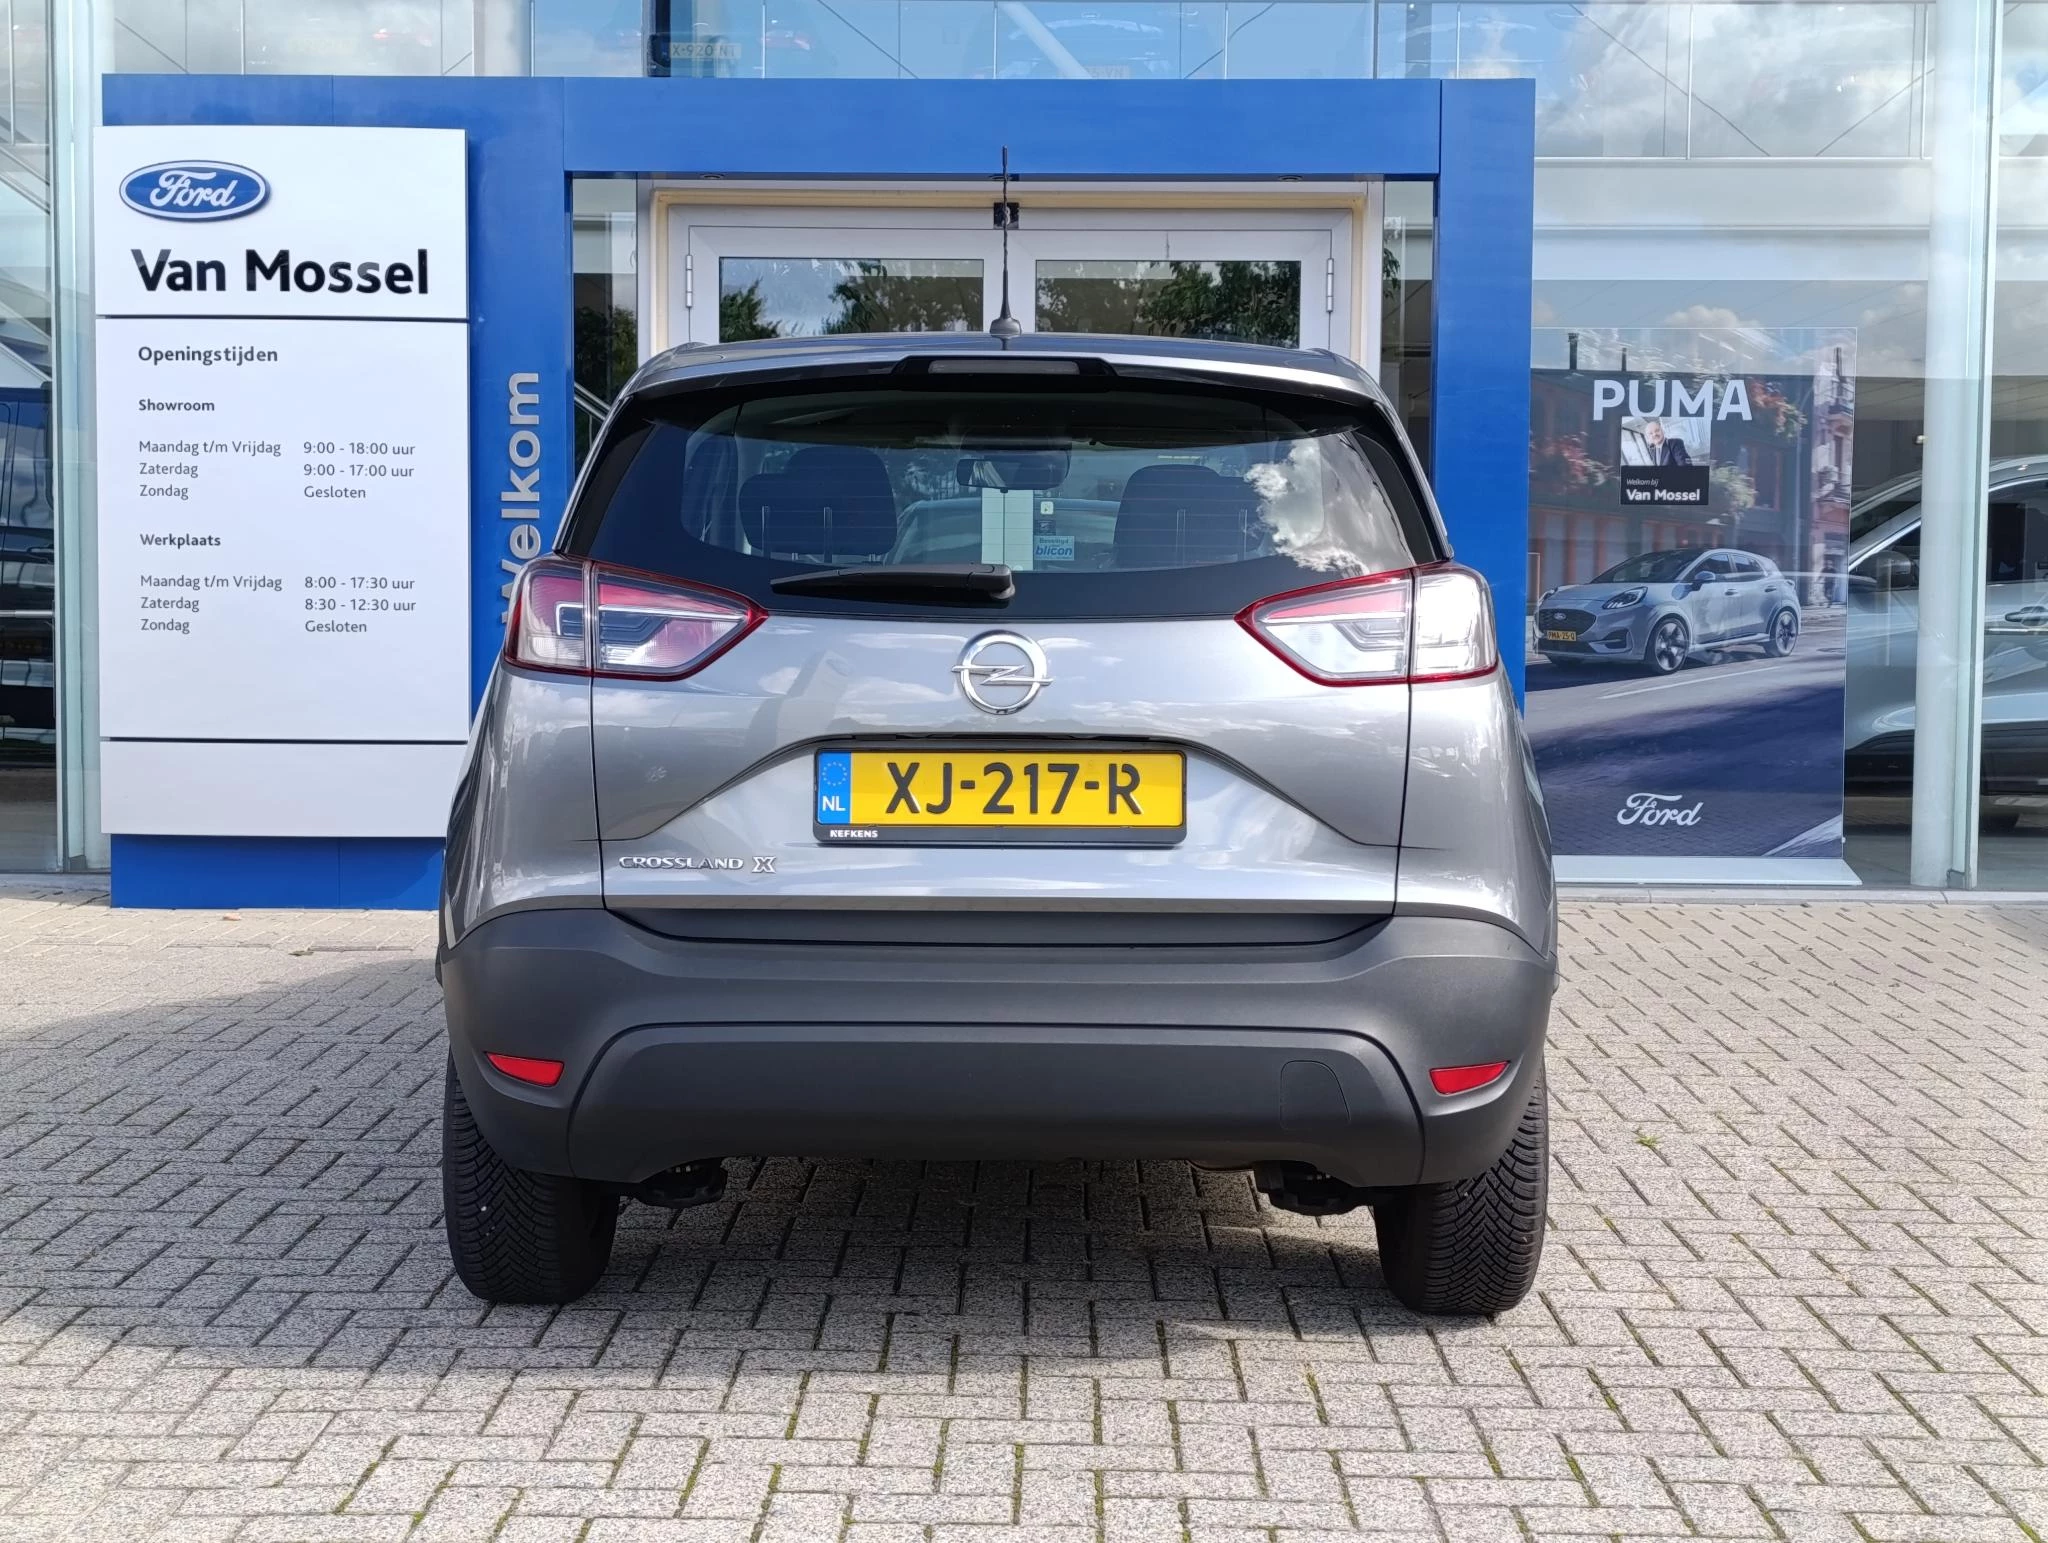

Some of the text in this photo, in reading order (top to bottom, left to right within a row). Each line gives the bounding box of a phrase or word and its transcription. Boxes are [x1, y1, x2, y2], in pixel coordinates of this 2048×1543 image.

[149, 169, 238, 207] Ford
[131, 249, 428, 294] Van Mossel
[139, 346, 277, 366] Openingstijden
[139, 399, 214, 411] Showroom
[1593, 379, 1752, 421] PUMA
[140, 440, 199, 456] Maandag
[203, 440, 227, 453] t/m
[232, 441, 281, 457] Vrijdag
[304, 442, 334, 453] 9:00
[349, 443, 388, 454] 18:00
[393, 446, 415, 455] uur
[140, 462, 198, 478] Zaterdag
[304, 464, 335, 476] 9:00
[350, 464, 386, 476] 17:00
[392, 468, 414, 477] uur
[1650, 478, 1659, 488] bij
[140, 484, 365, 500] Zondag Gesloten
[1626, 488, 1700, 501] Van Mossel
[140, 534, 221, 549] Werkplaats
[1035, 545, 1073, 556] blicon
[141, 575, 200, 591] Maandag
[204, 576, 228, 587] t/m
[233, 576, 282, 591] Vrijdag
[305, 577, 336, 588] 8:00
[351, 577, 387, 589] 17:30
[392, 581, 415, 589] uur
[141, 597, 199, 612] Zaterdag
[305, 599, 336, 610] 8:30
[351, 599, 388, 611] 12:30
[394, 603, 416, 611] uur
[141, 618, 366, 634] Zondag Gesloten
[885, 762, 1142, 815] XJ-217-R
[822, 796, 846, 812] NL
[1617, 792, 1704, 826] Ford
[830, 829, 878, 838] NEFKENS
[618, 856, 777, 874] CROSSLAND X
